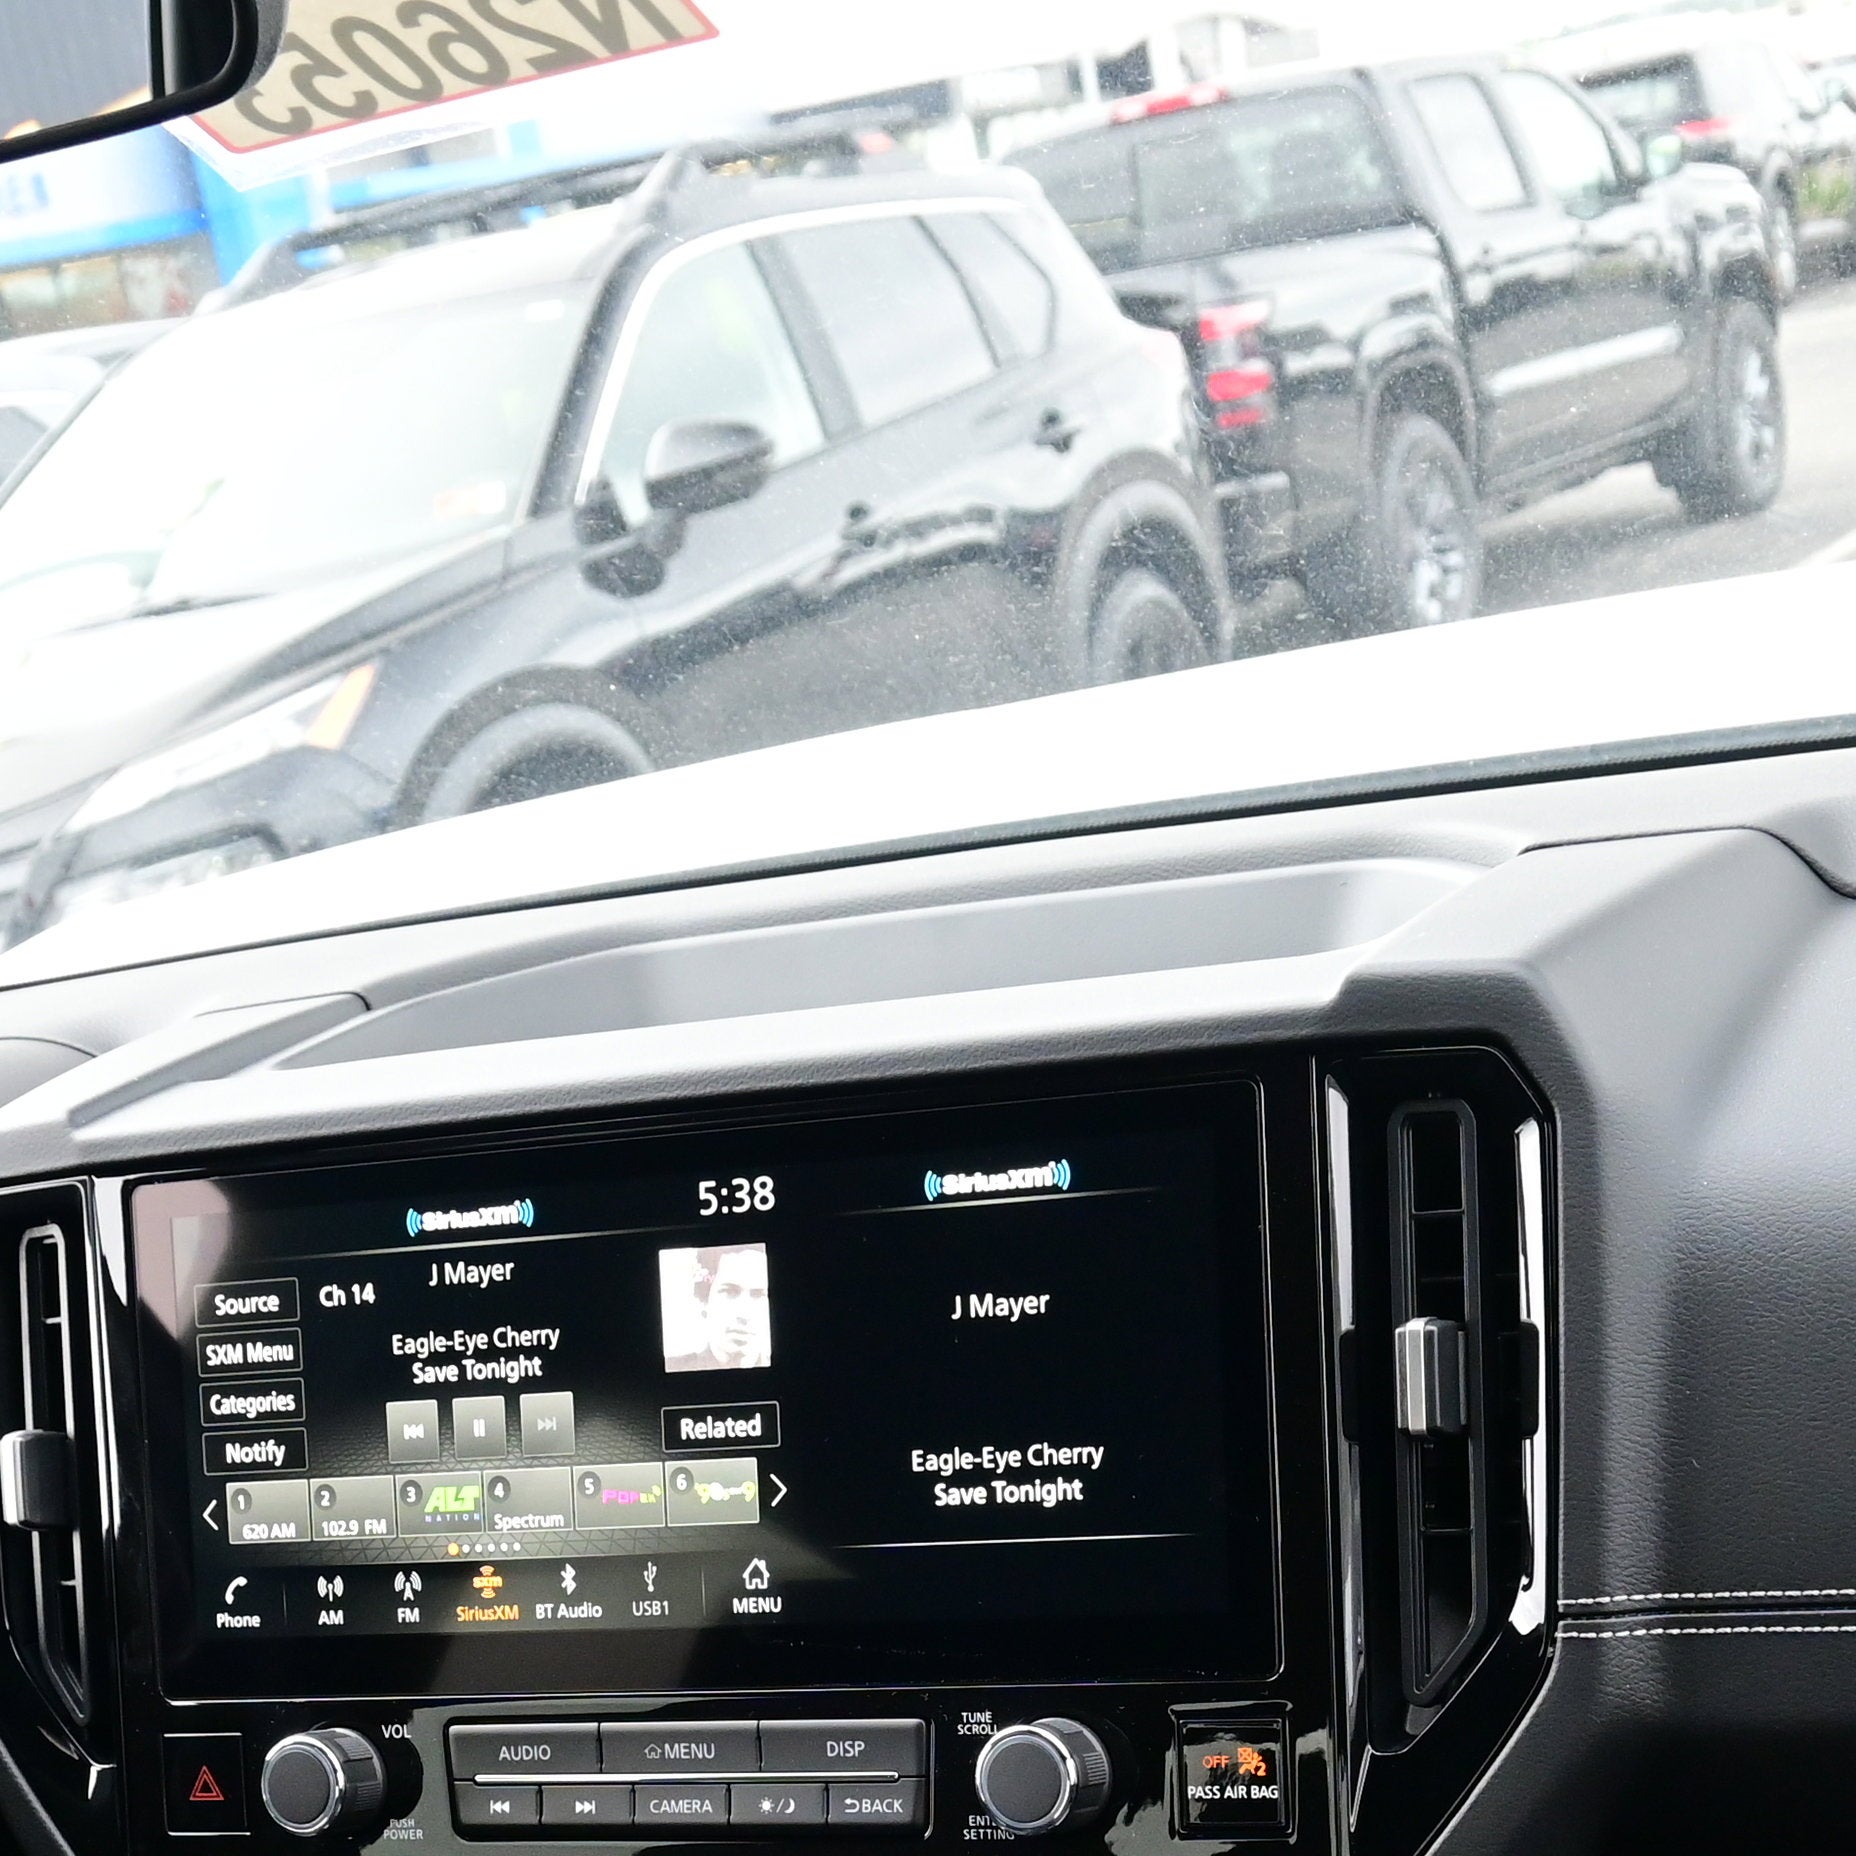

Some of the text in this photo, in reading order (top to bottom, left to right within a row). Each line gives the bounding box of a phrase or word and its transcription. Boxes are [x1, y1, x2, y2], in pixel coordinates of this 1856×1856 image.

[699, 1176, 775, 1216] 5:38
[429, 1261, 514, 1288] J Mayer
[319, 1283, 375, 1307] Ch 14
[215, 1294, 279, 1315] Source
[951, 1292, 1049, 1322] J Mayer
[392, 1325, 560, 1358] Eagle-Eye Cherry
[206, 1342, 294, 1366] SXM Menu
[412, 1354, 543, 1384] Save Tonight
[210, 1391, 295, 1418] Categories
[680, 1415, 761, 1440] Related
[225, 1440, 285, 1466] Notify
[911, 1442, 1103, 1476] Eagle-Eye Cherry
[424, 1485, 479, 1512] ALT
[934, 1478, 1082, 1507] Save Tonight
[425, 1513, 480, 1522] NATION
[494, 1513, 564, 1532] Spectrum
[243, 1523, 295, 1539] 620 AM
[322, 1519, 386, 1536] 102.9 FM
[456, 1605, 519, 1621] SiriusXM
[536, 1602, 602, 1619] BT Audio
[633, 1601, 668, 1616] USB1
[733, 1597, 782, 1614] MENU
[216, 1613, 261, 1628] Phone
[318, 1610, 343, 1625] AM
[398, 1608, 419, 1622] FM
[961, 1712, 992, 1723] TUNE
[382, 1725, 412, 1739] VOL
[958, 1724, 998, 1735] SCROLL
[499, 1745, 551, 1761] AUDIO
[665, 1743, 715, 1760] MENU
[826, 1741, 865, 1757] DISP
[1202, 1755, 1229, 1769] OFF
[1188, 1785, 1278, 1800] PASS AIR BAG
[649, 1799, 712, 1815] CAMERA
[861, 1797, 903, 1813] BACK
[389, 1818, 415, 1828] PUSH
[383, 1829, 424, 1841] POWER
